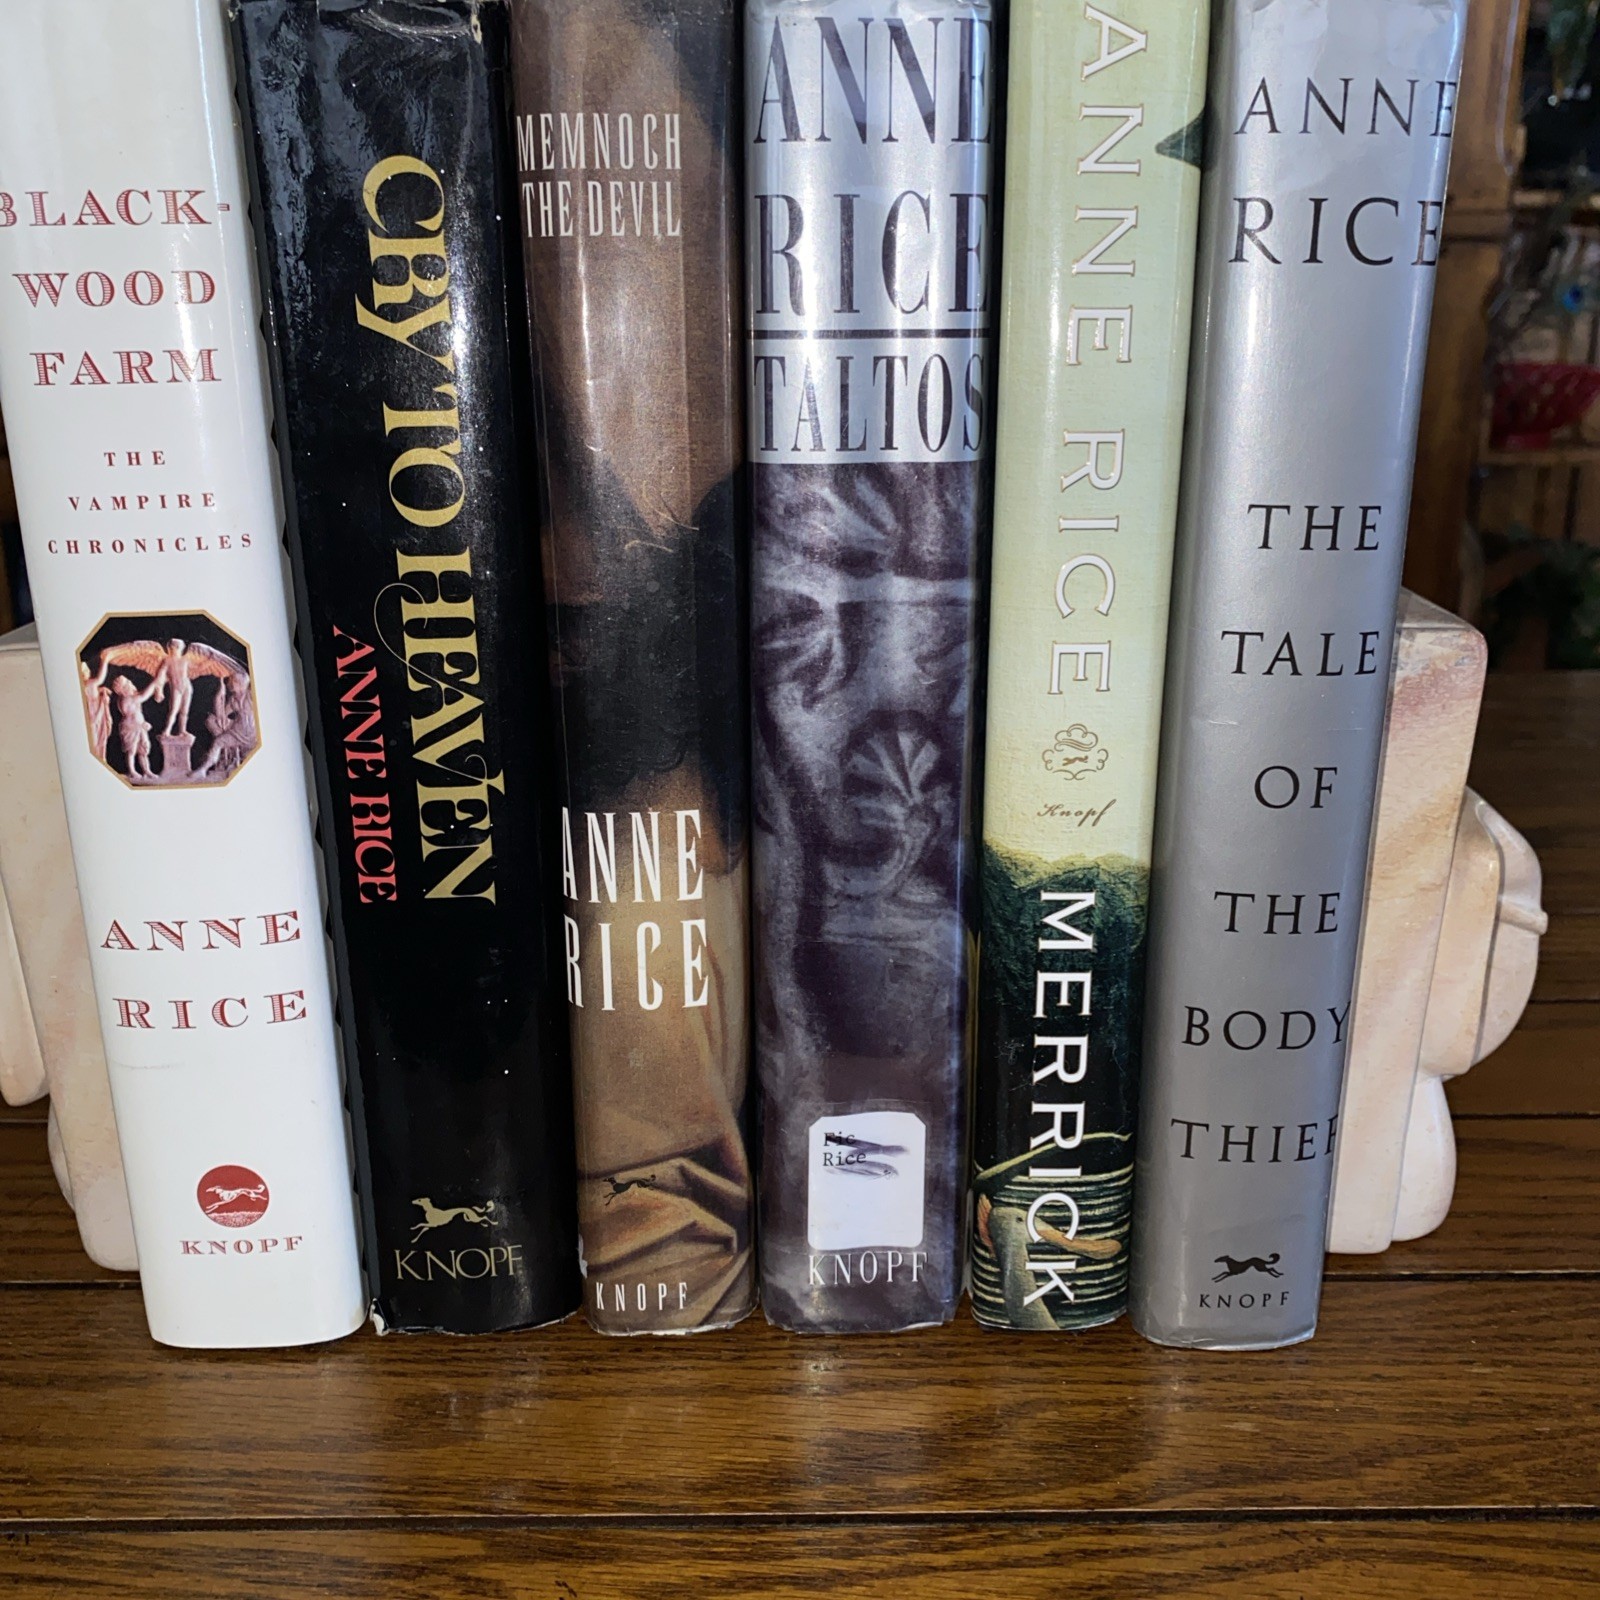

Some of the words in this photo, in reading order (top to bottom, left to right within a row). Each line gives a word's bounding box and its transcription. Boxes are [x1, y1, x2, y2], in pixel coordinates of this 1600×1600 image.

[753, 15, 992, 145] ANNE
[1233, 76, 1458, 138] ANNE
[516, 112, 682, 172] MEMNOCH
[1065, 2, 1149, 367] ANNE
[522, 180, 574, 238] THE
[587, 180, 682, 237] DEVIL
[1228, 196, 1443, 266] RICE
[354, 154, 456, 373] CRY
[754, 189, 989, 316] RICE
[12, 270, 215, 307] WOOD
[30, 348, 222, 386] FARM
[753, 352, 986, 454] TALTOS
[104, 450, 166, 467] THE
[382, 381, 466, 528] TO
[68, 493, 216, 511] VAMPIRE
[47, 533, 253, 555] CHRONICLES
[1247, 504, 1382, 551] THE
[1047, 428, 1126, 696] RICE
[1221, 630, 1380, 676] TALE
[332, 624, 388, 779] ANNE
[373, 545, 505, 906] HEAVEN
[1254, 765, 1338, 809] OF
[1036, 798, 1118, 828] Knopf
[350, 793, 398, 904] RICE
[561, 806, 705, 905] ANNE
[100, 910, 302, 951] ANNE
[1214, 891, 1341, 935] THE
[563, 912, 710, 1012] RICE
[112, 990, 307, 1030] RICE
[1181, 1001, 1351, 1051] BODY
[1023, 890, 1097, 1307] MERRICK
[823, 1151, 867, 1167] Rice
[179, 1236, 304, 1255] KNOPF
[395, 1244, 523, 1280] KNOPF
[808, 1250, 929, 1286] KNOPF
[595, 1281, 688, 1312] KNOPF
[1199, 1290, 1290, 1308] KNOPF
